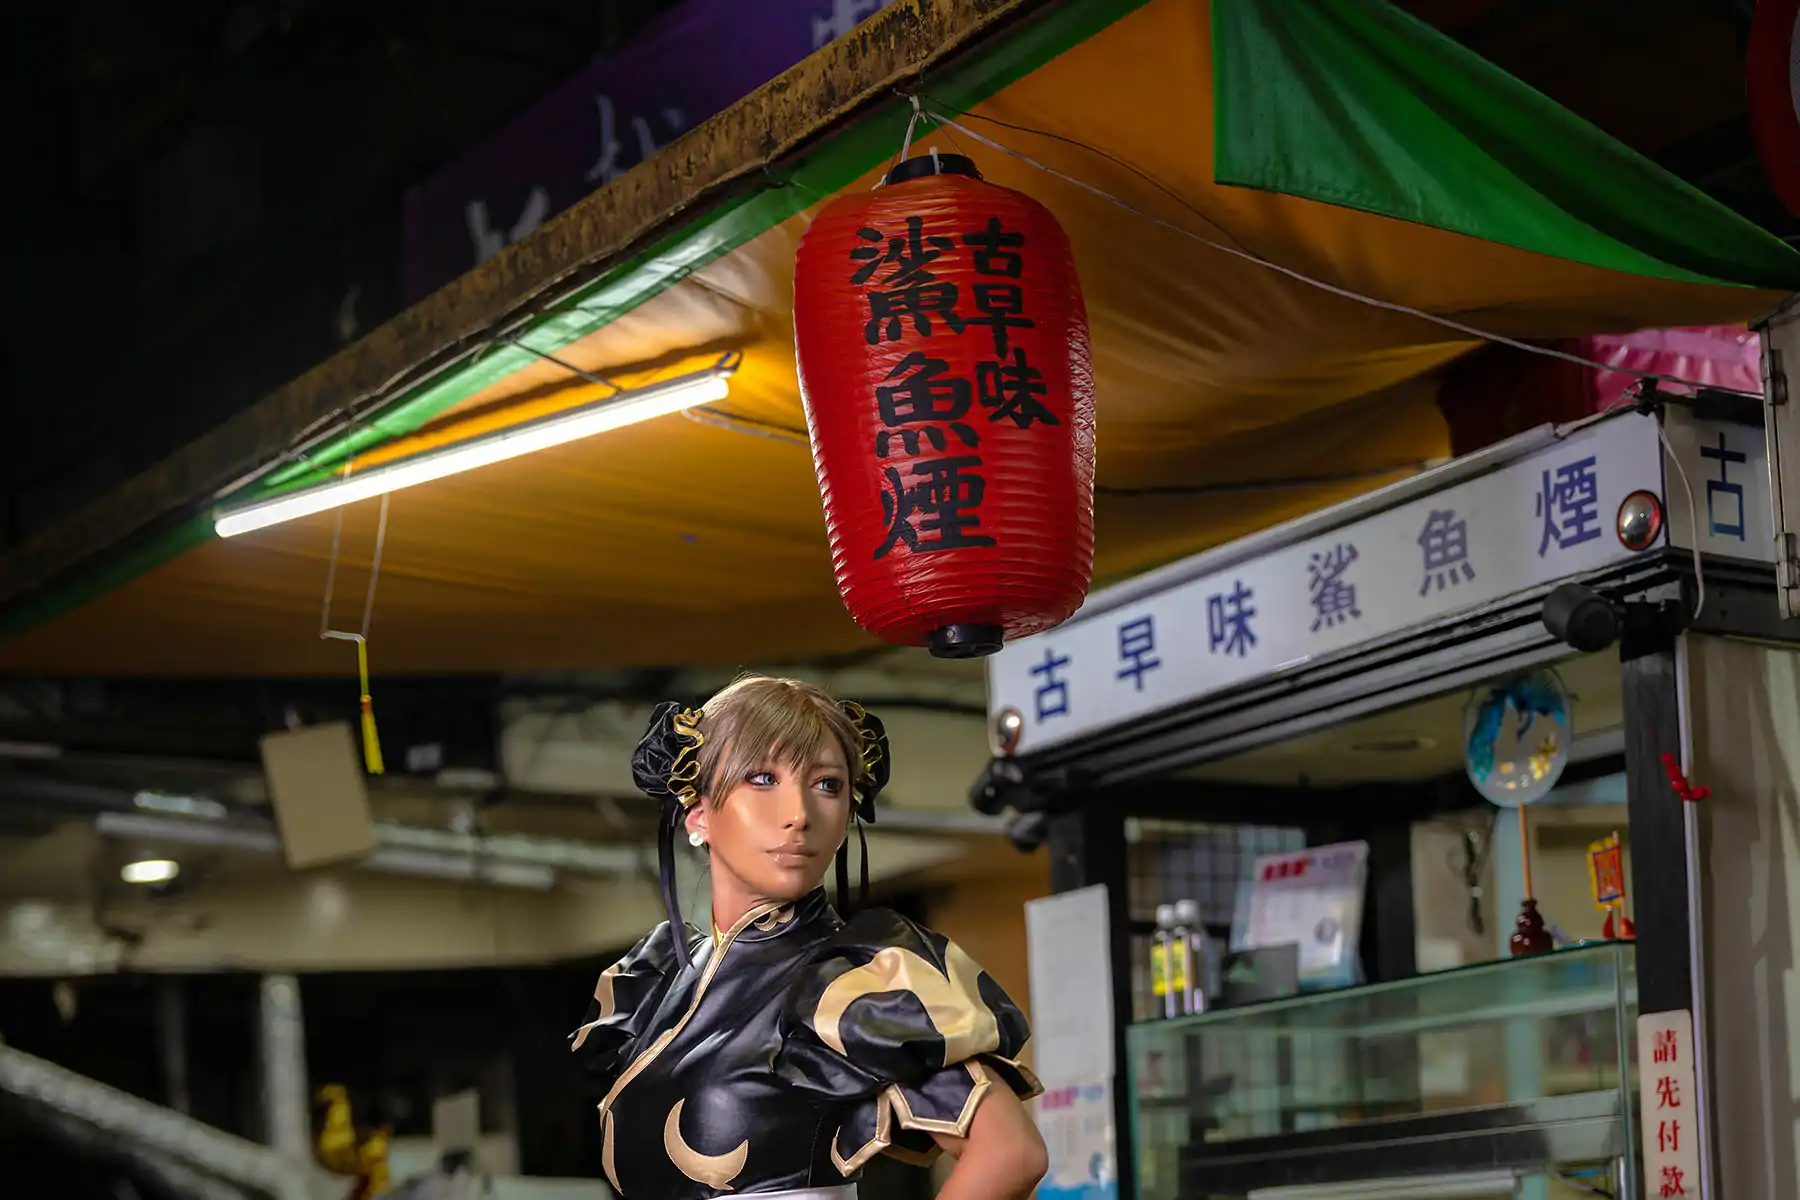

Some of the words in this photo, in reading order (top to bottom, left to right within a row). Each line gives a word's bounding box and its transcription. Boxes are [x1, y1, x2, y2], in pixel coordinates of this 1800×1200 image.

[850, 215, 998, 562] 鯊魚煙
[962, 217, 1061, 429] 古早味
[1029, 454, 1603, 726] 古早味鯊魚煙
[1700, 432, 1747, 542] 古
[1652, 1028, 1685, 1200] 請先付款
